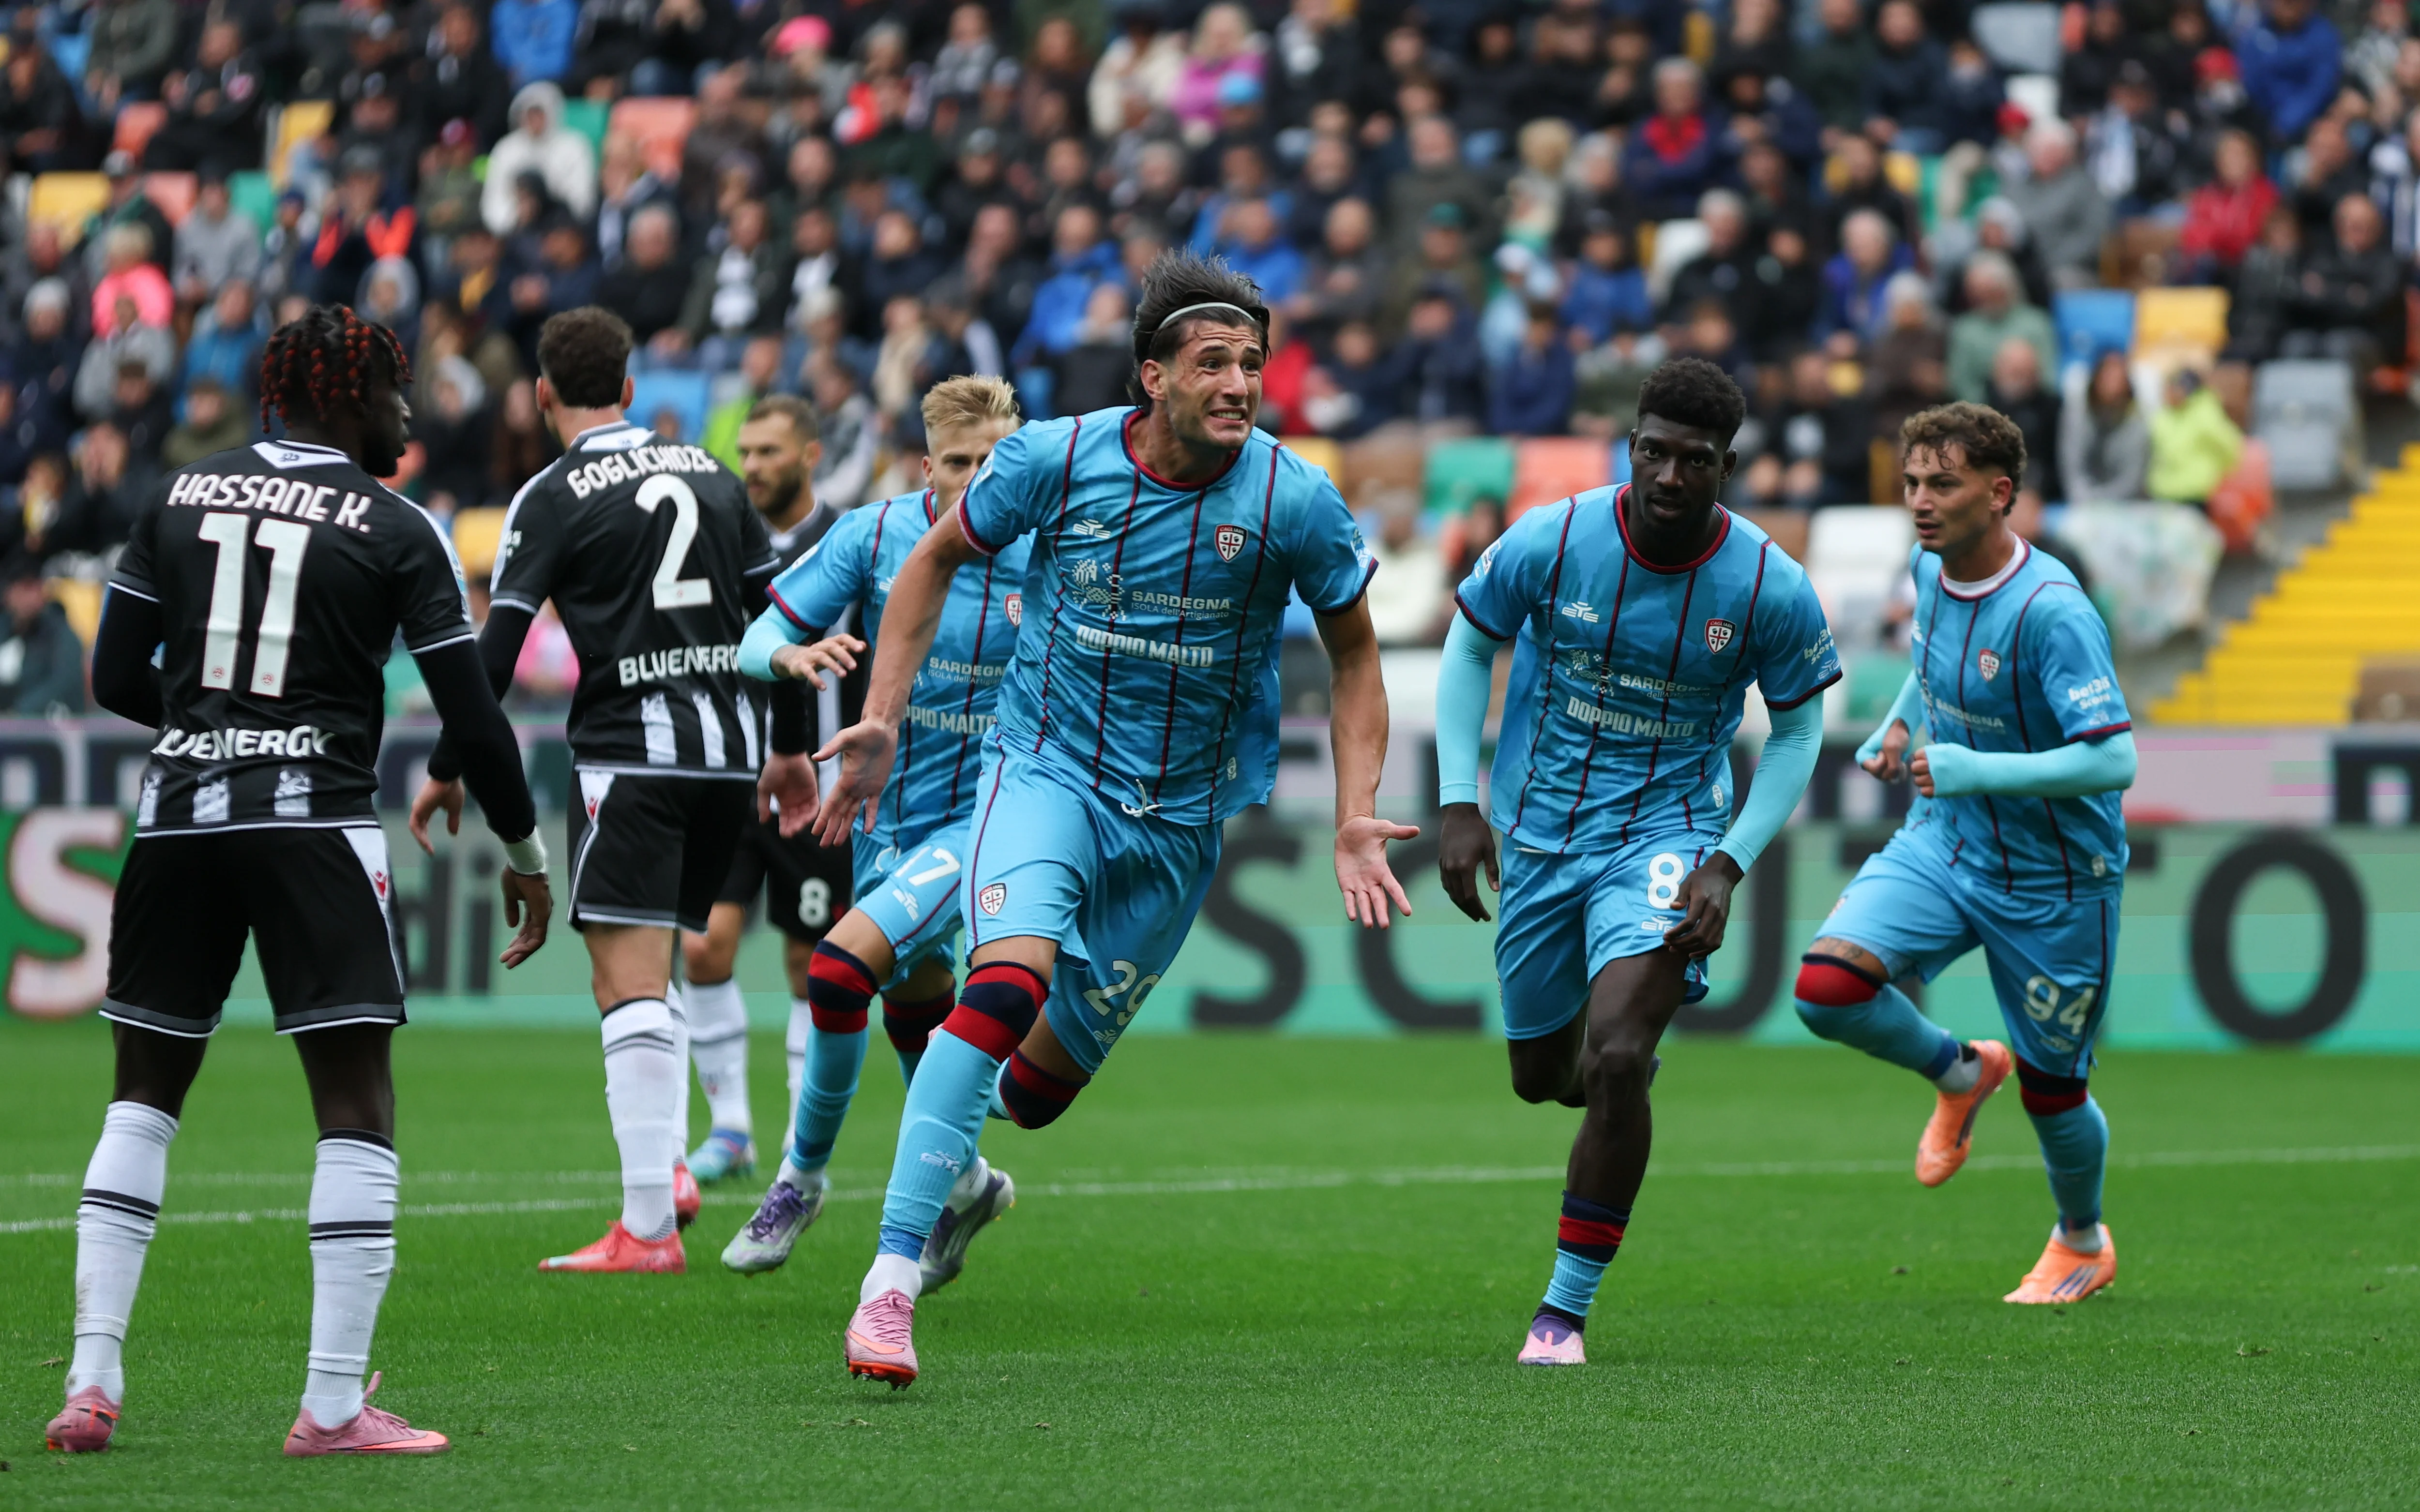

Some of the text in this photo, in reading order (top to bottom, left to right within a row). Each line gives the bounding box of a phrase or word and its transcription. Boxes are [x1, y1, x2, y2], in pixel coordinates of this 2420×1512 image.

[567, 445, 720, 499] GOGLICHIDZE
[166, 473, 372, 533] HASSANE K.
[635, 473, 712, 610] 2
[1220, 526, 1244, 535] CAGLIARI
[198, 511, 311, 698] 11
[1132, 590, 1230, 610] SARDEGNA
[1132, 602, 1229, 621] ISOLA dell'Artigianato
[1076, 624, 1213, 668] DOPPIO MALTO
[1710, 621, 1733, 629] CAGLIARI
[618, 644, 739, 688] BLUENERG
[928, 669, 952, 681] ISOLA
[929, 657, 1005, 677] SARDEGN
[903, 704, 937, 729] PPIO
[1567, 695, 1694, 738] DOPPIO MALTO
[894, 845, 961, 886] 17
[1647, 852, 1684, 910] 8
[798, 877, 832, 928] 8
[1082, 959, 1160, 1026] 29
[2023, 974, 2095, 1035] 94
